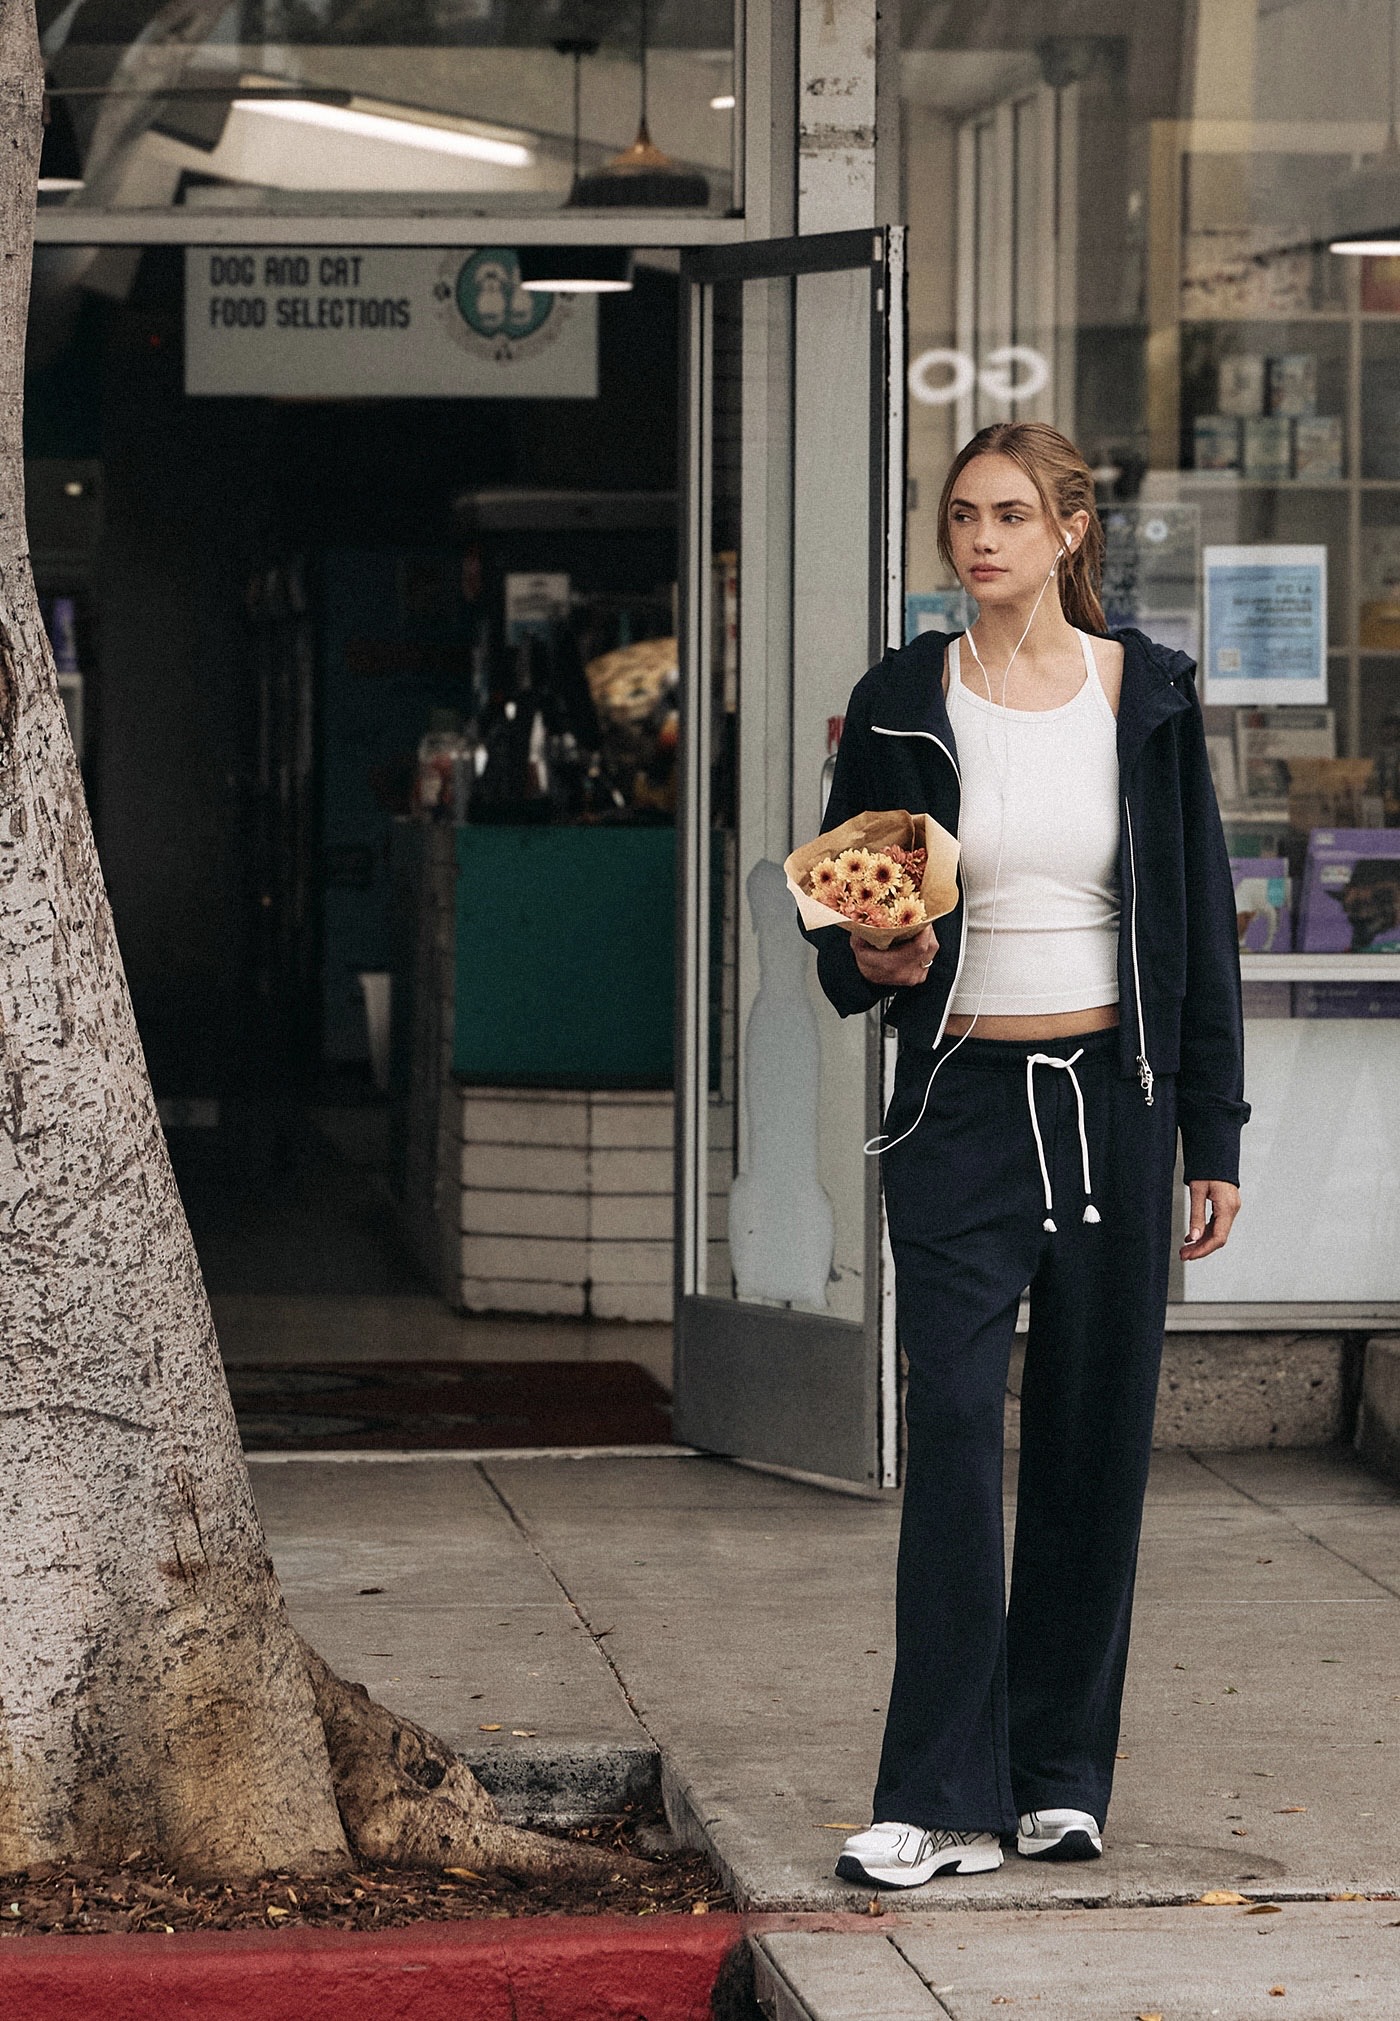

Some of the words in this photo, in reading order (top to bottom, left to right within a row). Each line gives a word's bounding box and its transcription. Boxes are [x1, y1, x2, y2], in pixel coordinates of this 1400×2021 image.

[210, 256, 255, 287] DOG
[264, 256, 310, 287] AND
[319, 256, 363, 287] CAT
[210, 298, 266, 328] FOOD
[276, 298, 411, 329] SELECTIONS
